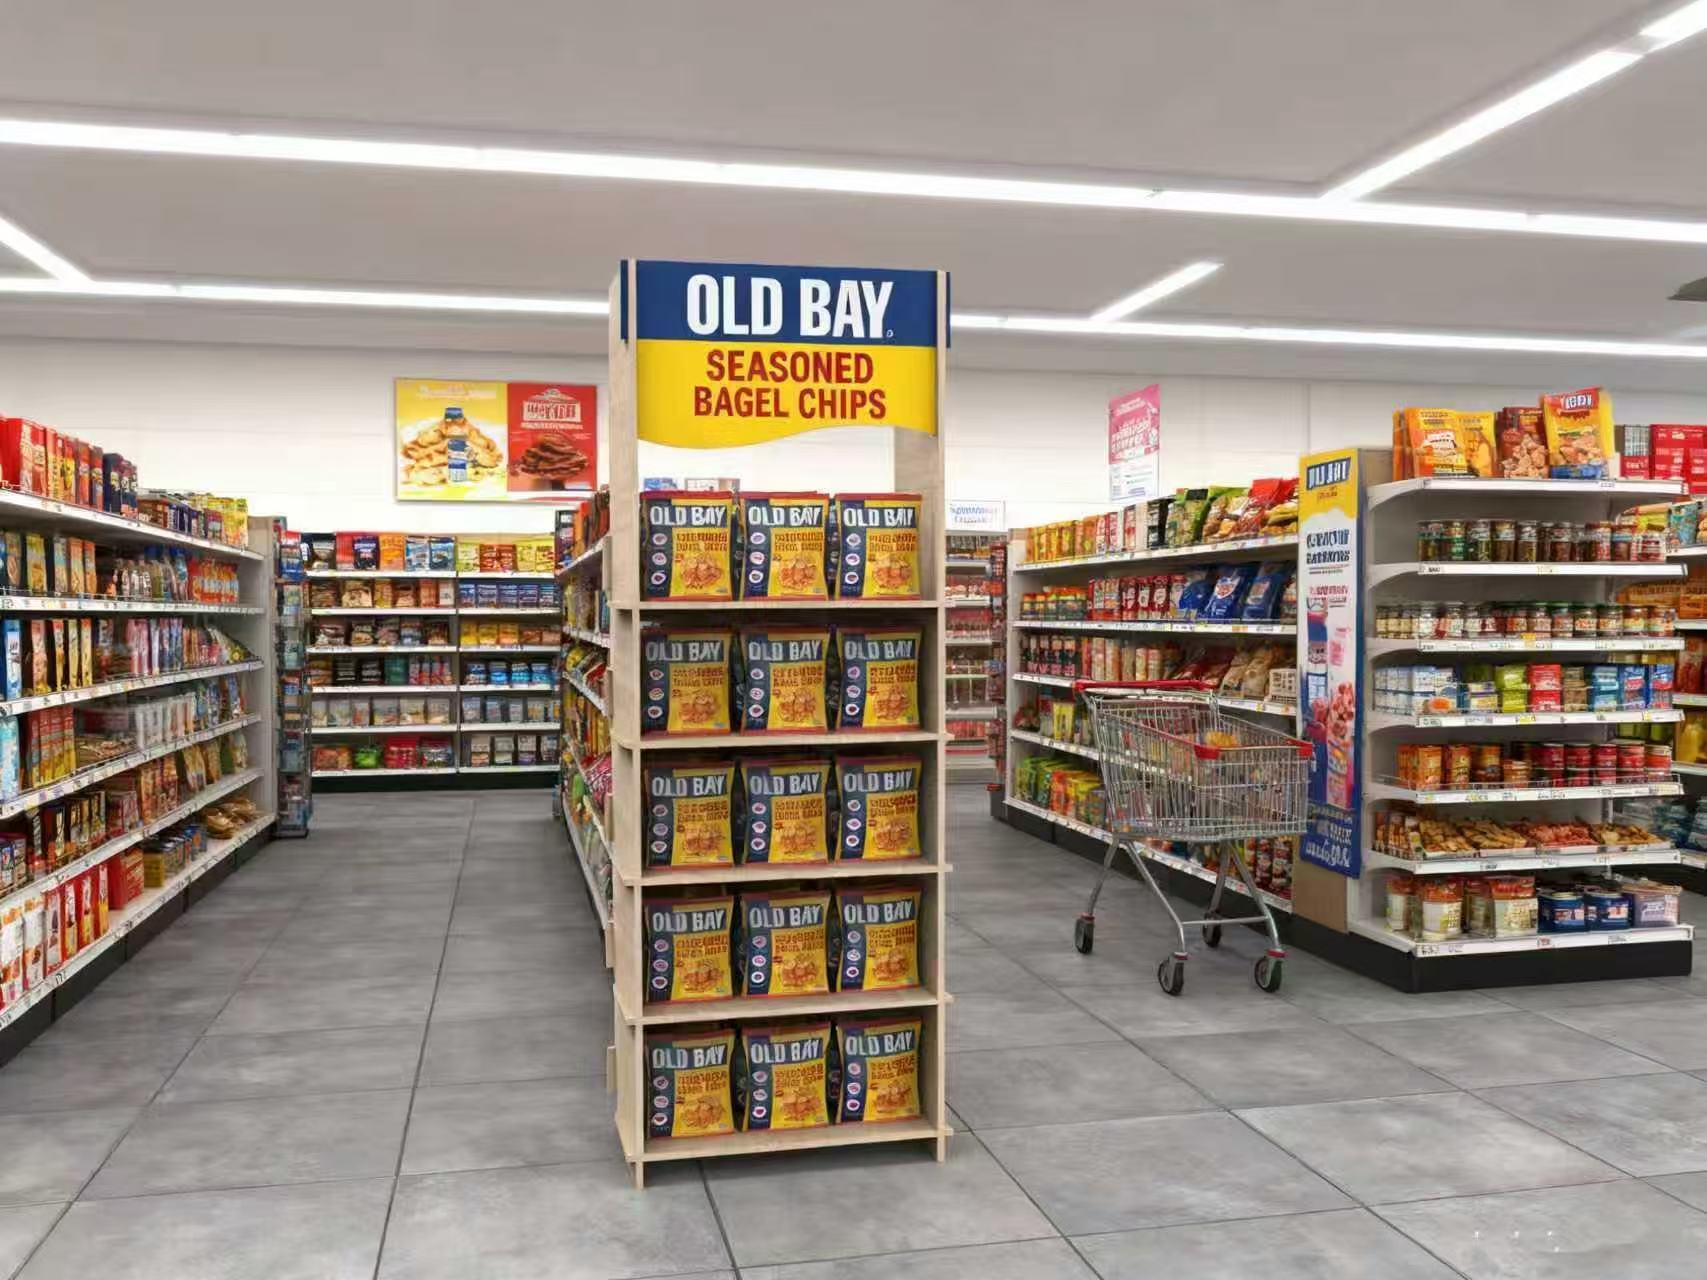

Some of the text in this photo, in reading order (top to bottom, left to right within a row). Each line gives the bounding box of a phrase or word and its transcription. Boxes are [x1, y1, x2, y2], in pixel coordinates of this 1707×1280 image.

[686, 274, 894, 339] OLD BAY
[706, 349, 873, 383] SEASONED
[694, 386, 886, 419] BAGEL CHIPS
[650, 506, 725, 526] OLD BAY
[748, 506, 822, 526] OLD BAY
[843, 508, 913, 527] OLD BAY
[646, 641, 721, 660] OLD BAY
[748, 640, 821, 660] OLD BAY
[844, 641, 912, 659] OLD BAY
[652, 775, 724, 796] OLD BAY
[750, 774, 820, 794] OLD BAY
[844, 771, 912, 792] OLD BAY
[652, 910, 724, 932] OLD BAY
[750, 906, 820, 928] OLD BAY
[844, 900, 912, 924] OLD BAY
[751, 1039, 819, 1064] OLD BAY
[846, 1032, 912, 1056] OLD BAY
[652, 1046, 724, 1068] OLD BAY
